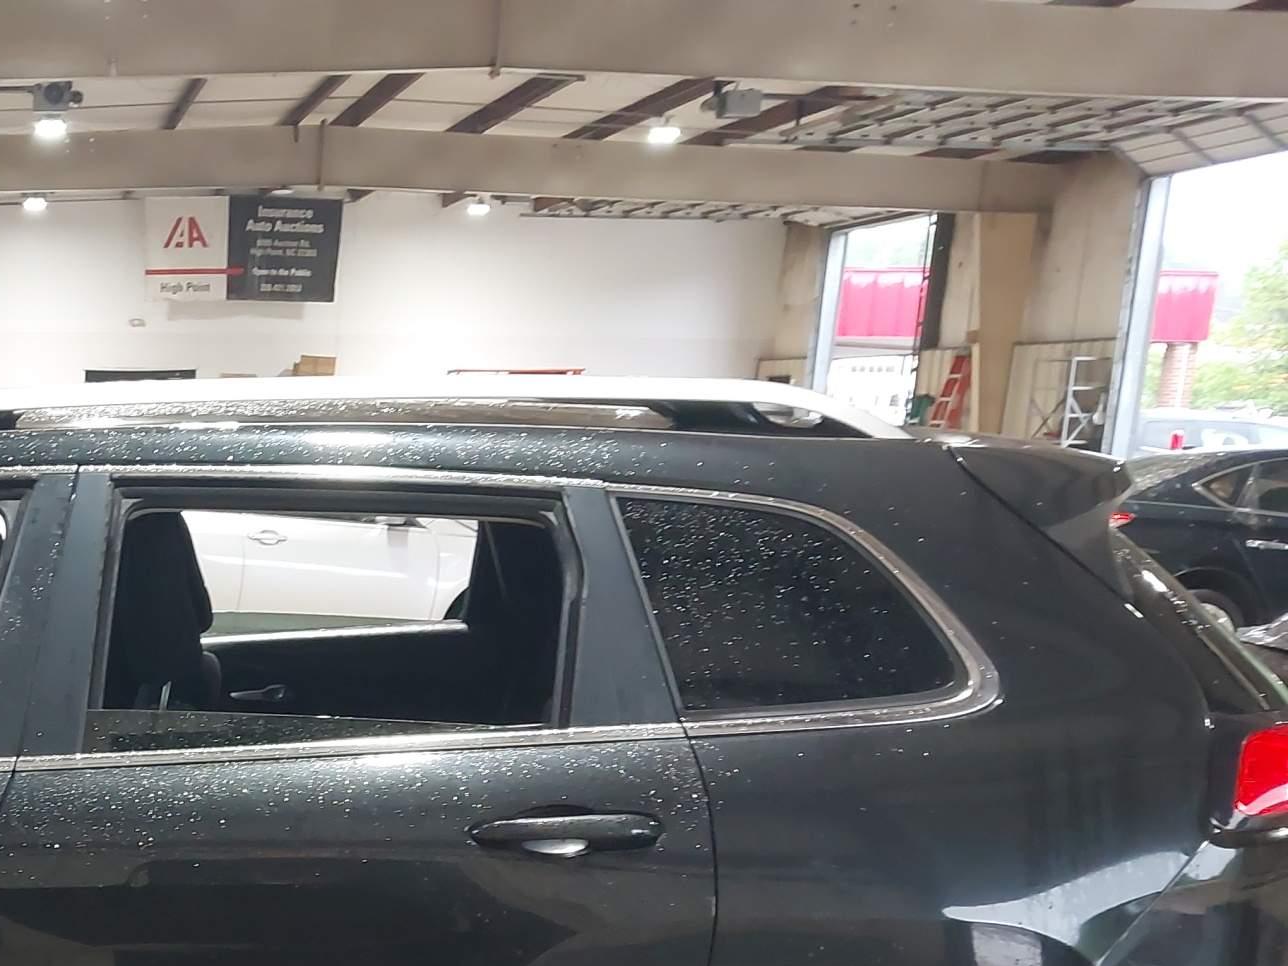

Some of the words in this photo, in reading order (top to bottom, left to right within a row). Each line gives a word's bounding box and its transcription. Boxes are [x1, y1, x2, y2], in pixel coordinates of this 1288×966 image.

[258, 205, 314, 219] Insurance
[246, 219, 273, 232] Auto
[274, 220, 324, 234] Auctions
[160, 282, 183, 294] High
[186, 282, 210, 292] Point
